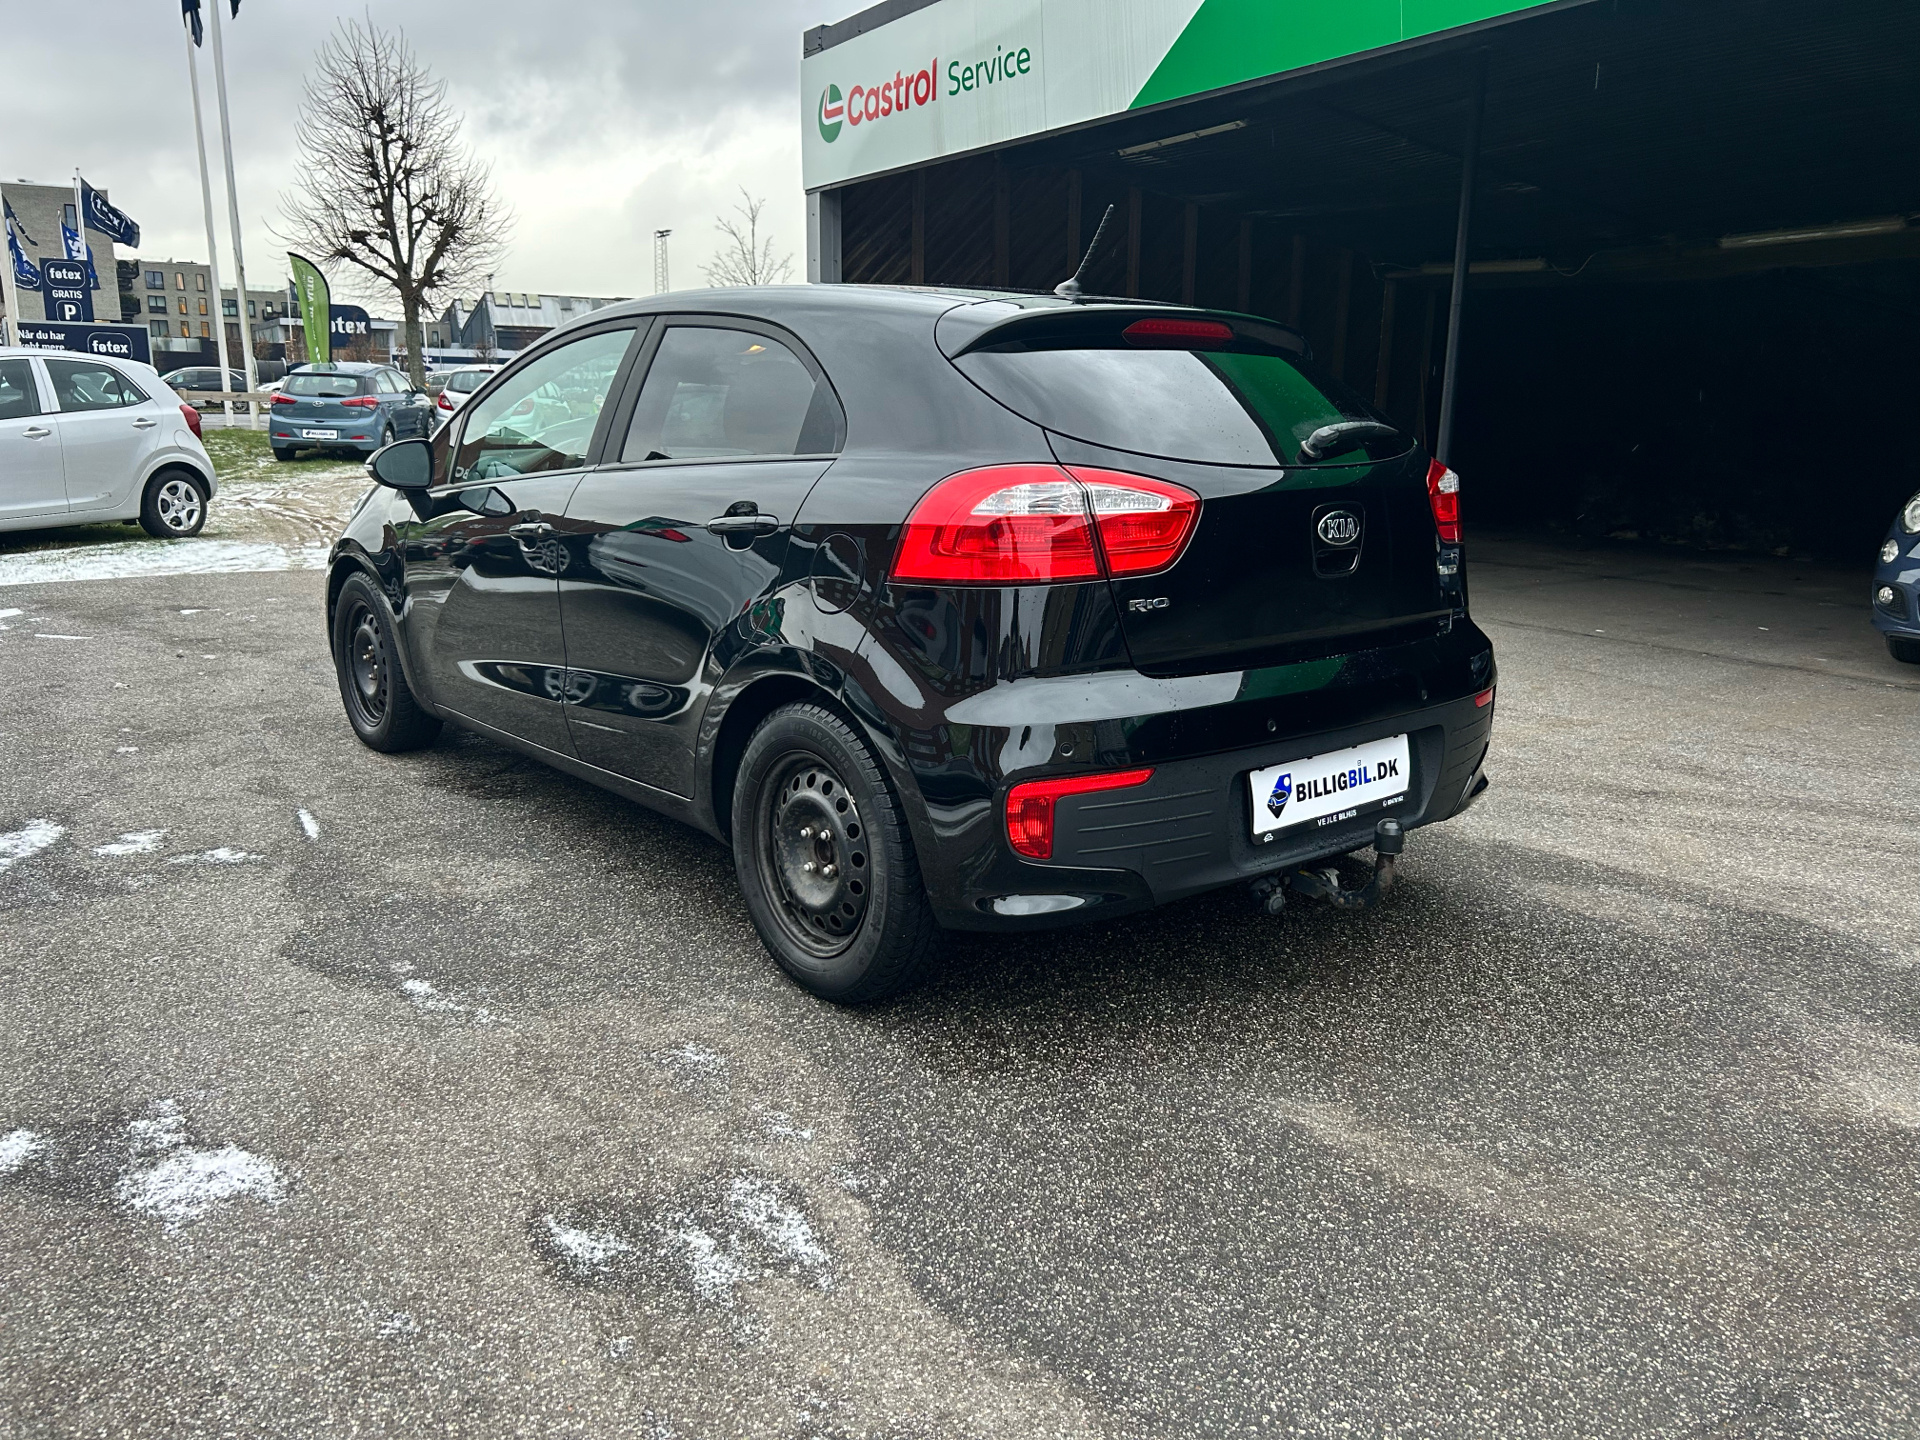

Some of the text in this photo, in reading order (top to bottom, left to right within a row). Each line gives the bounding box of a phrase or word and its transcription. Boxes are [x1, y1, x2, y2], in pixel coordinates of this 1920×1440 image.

[847, 45, 1031, 126] Castrol Service
[52, 289, 83, 299] GRATIS
[64, 304, 76, 320] P
[331, 316, 367, 334] tex
[36, 330, 49, 340] du
[50, 330, 65, 340] har
[1327, 518, 1355, 538] KIA
[1129, 597, 1170, 612] RIO
[1296, 758, 1399, 802] BILLIGBIL.DK
[1317, 815, 1338, 827] VEJLE
